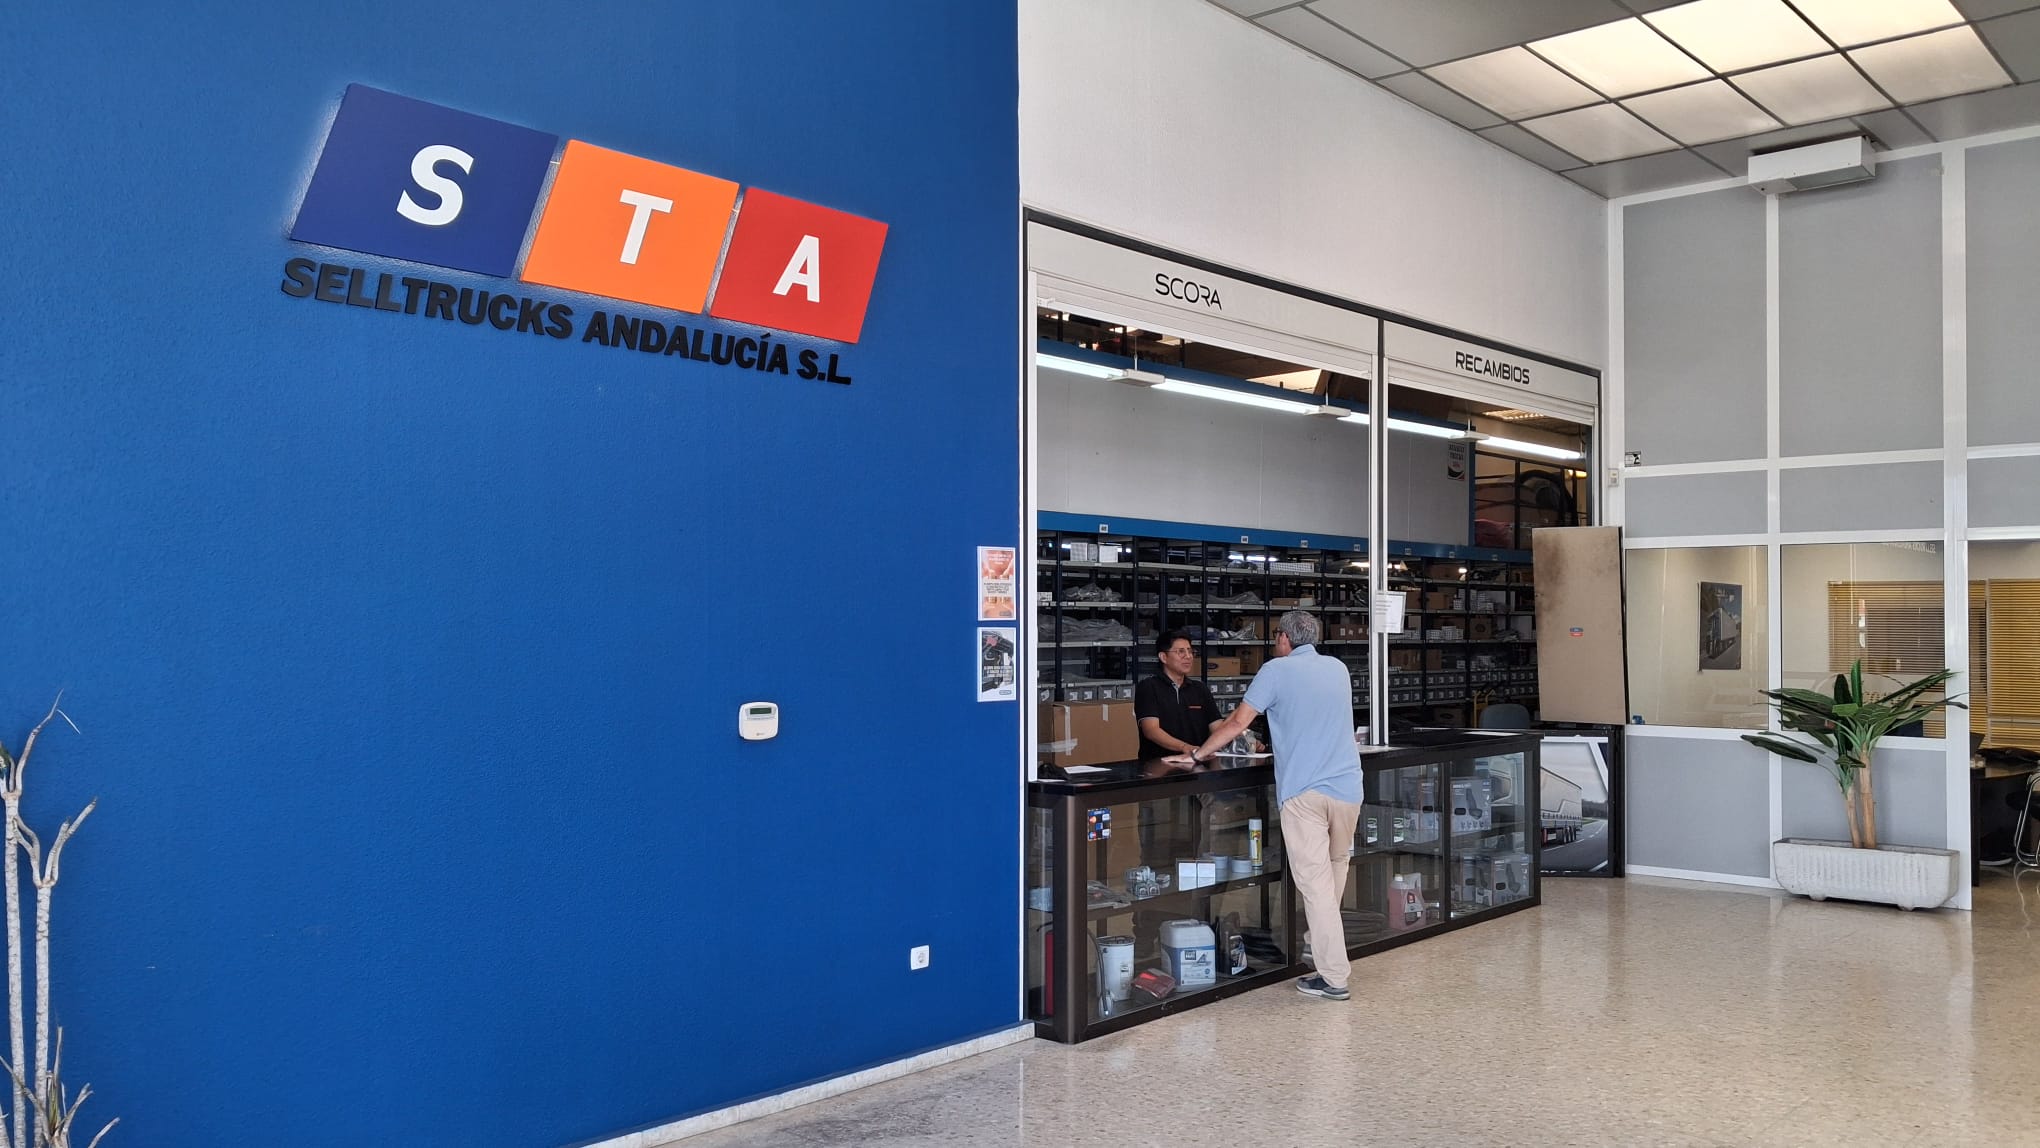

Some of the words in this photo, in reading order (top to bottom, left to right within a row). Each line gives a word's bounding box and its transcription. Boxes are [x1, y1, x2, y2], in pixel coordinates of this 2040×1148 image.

[1155, 273, 1222, 310] SCORA
[281, 258, 574, 340] SELLTRUCKS
[583, 311, 789, 376] ANDALUCÍA
[796, 349, 852, 385] S.L
[1455, 351, 1530, 385] RECAMBIOS
